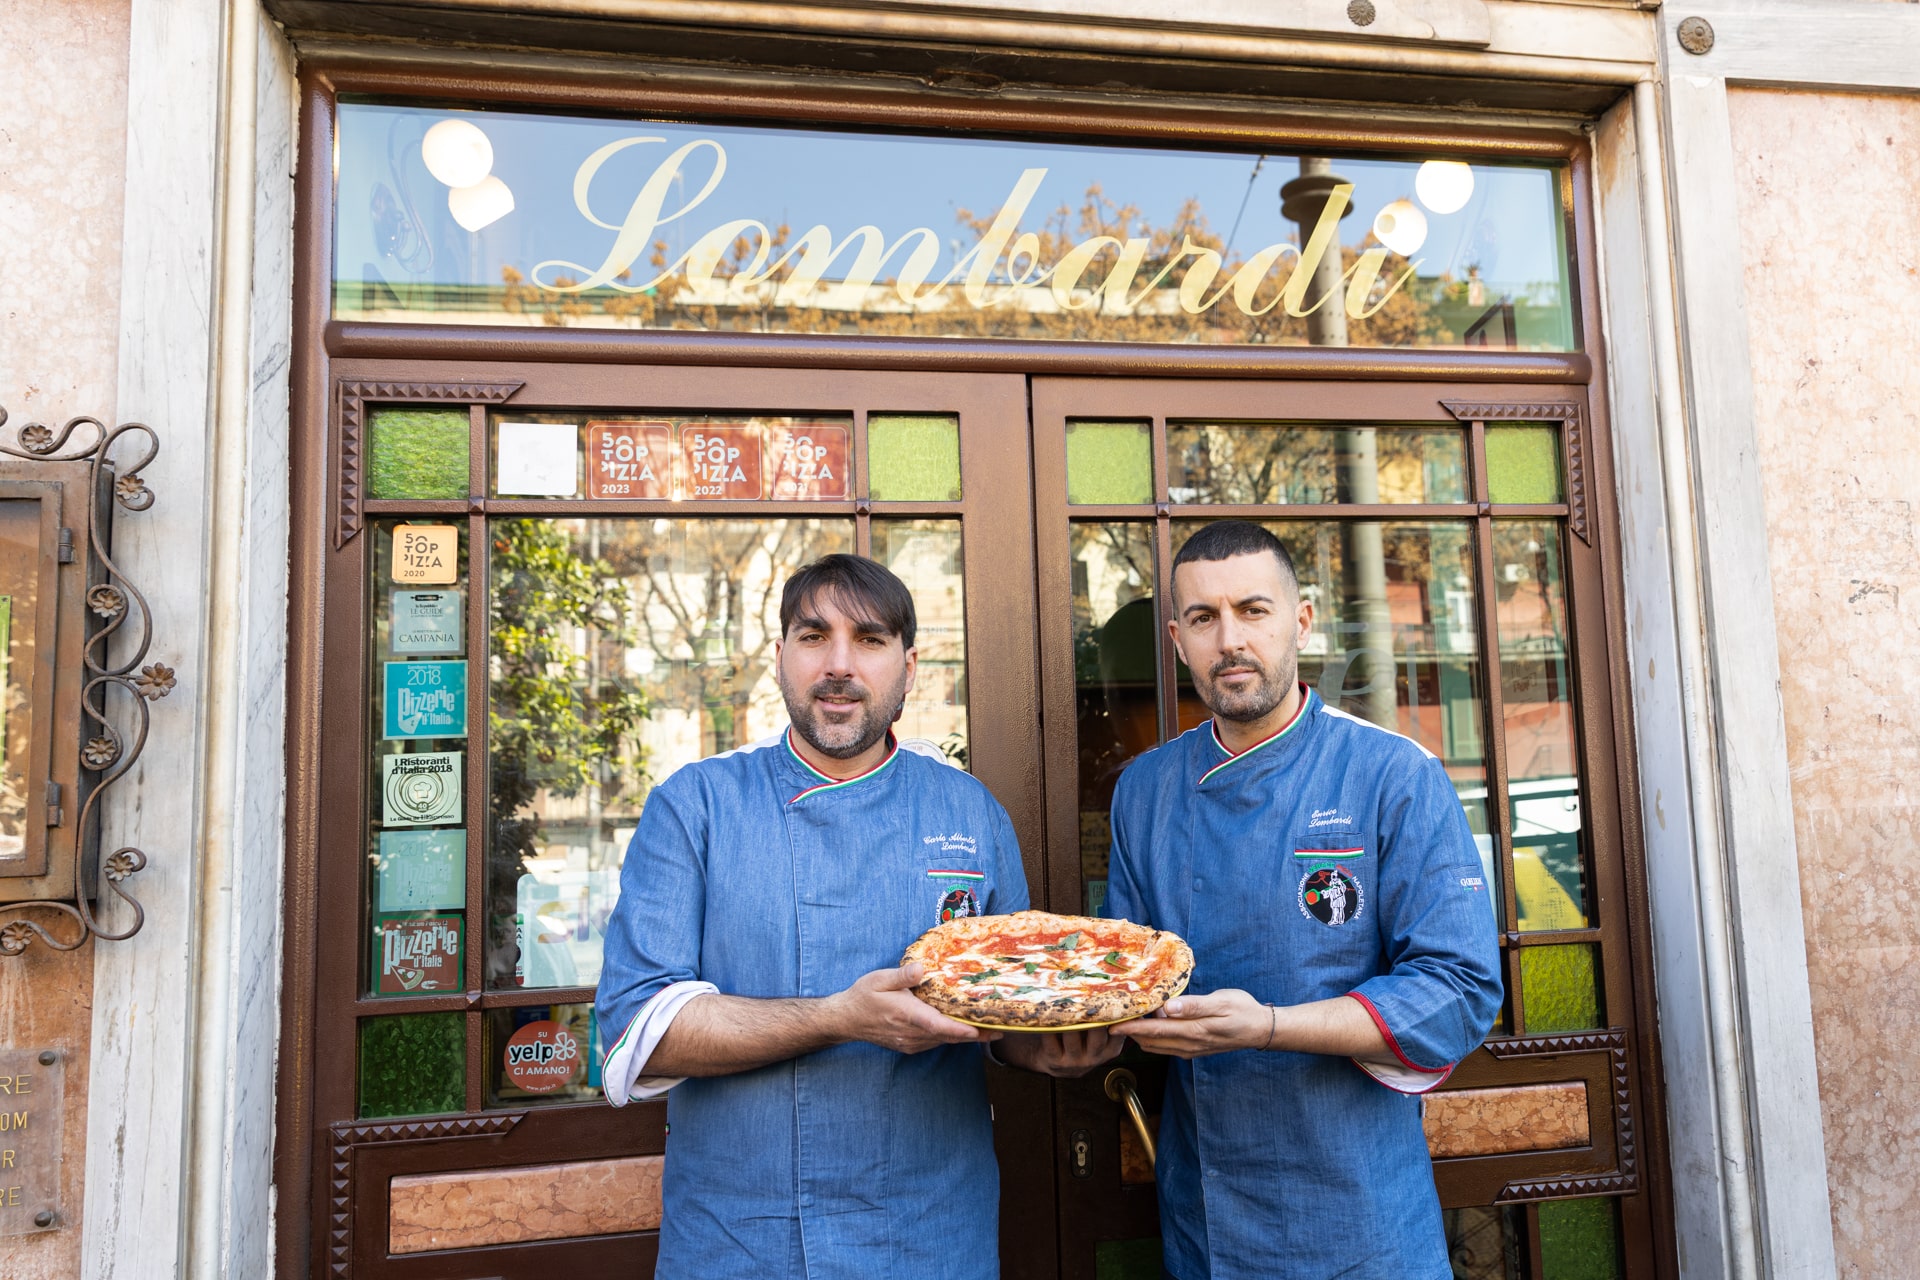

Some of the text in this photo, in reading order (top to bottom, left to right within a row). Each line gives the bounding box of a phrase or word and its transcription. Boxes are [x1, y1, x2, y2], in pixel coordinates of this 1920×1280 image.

[532, 136, 1425, 320] Lombardi
[601, 444, 649, 461] TOP
[693, 446, 740, 463] TOP
[784, 445, 827, 462] TOP
[602, 485, 630, 494] 2023
[695, 486, 722, 495] 2022
[404, 542, 438, 554] TOP
[399, 634, 454, 642] CAMPANIA
[408, 669, 441, 685] 2018
[400, 756, 450, 766] Ristoranti
[392, 765, 453, 775] d'Italia 2018
[1311, 808, 1338, 819] Enrico
[1308, 815, 1353, 828] Lombardi
[1297, 872, 1312, 920] ASSOCIAZIONE
[1352, 876, 1365, 920] NAPOLETANA
[509, 1041, 554, 1064] yelp
[513, 1066, 570, 1075] CI AMANO!
